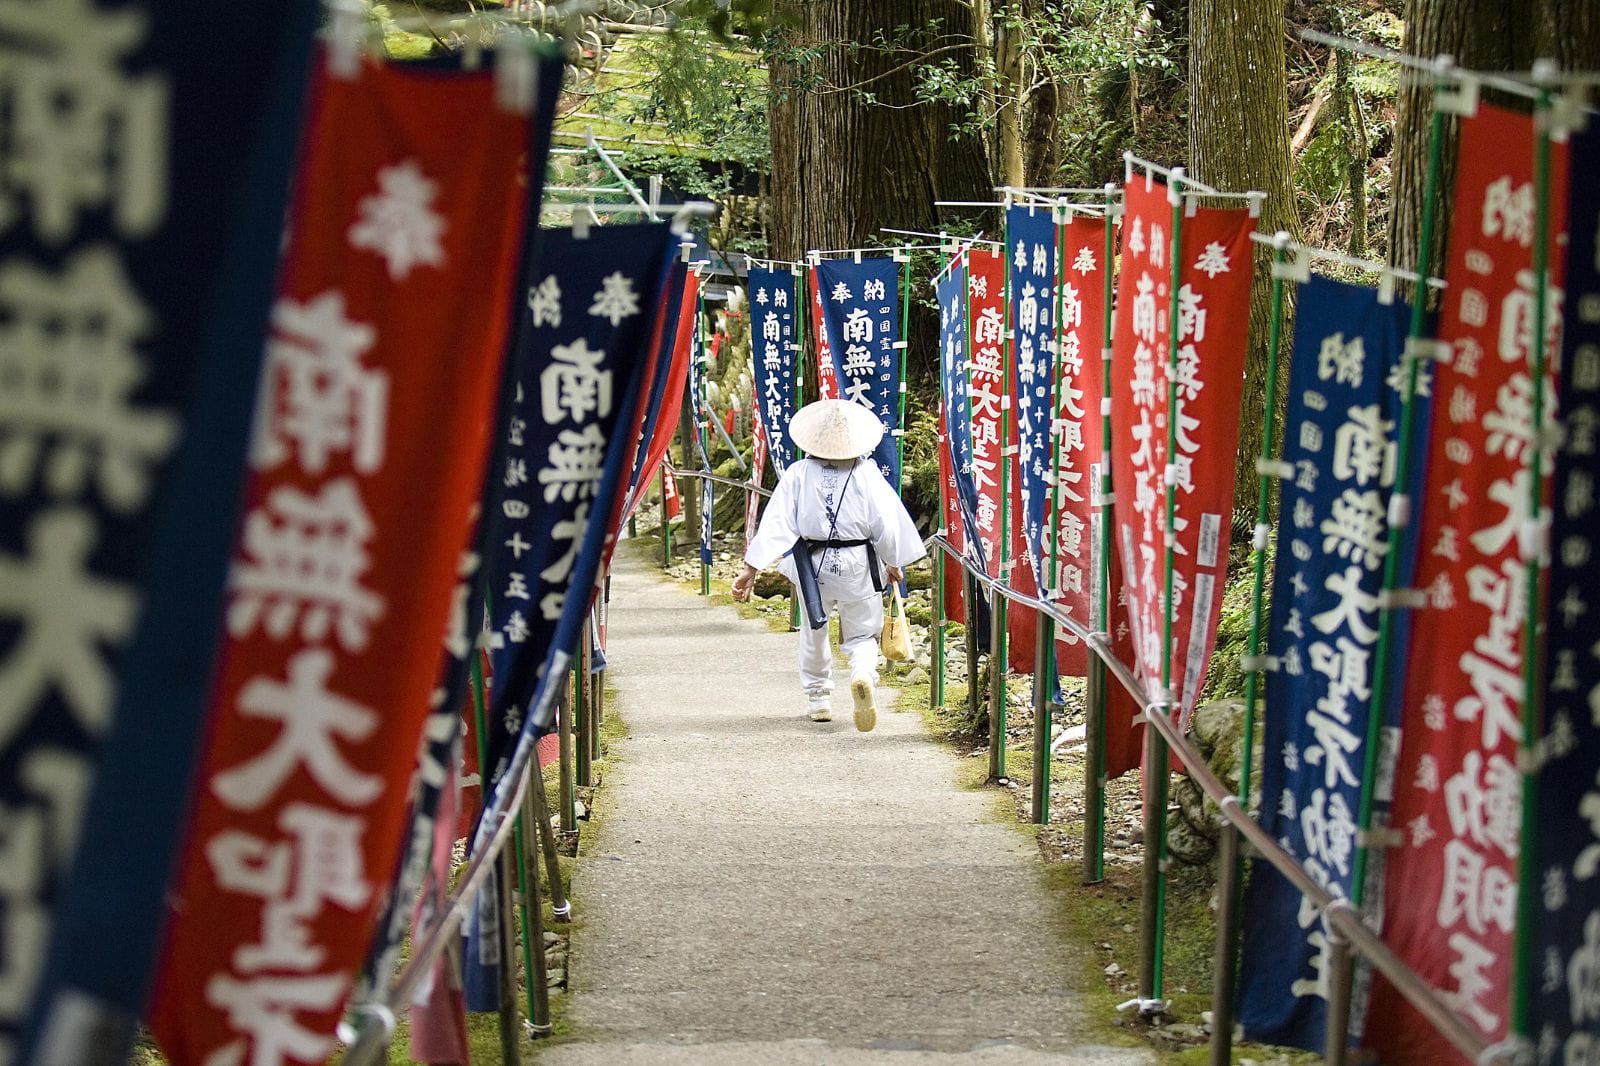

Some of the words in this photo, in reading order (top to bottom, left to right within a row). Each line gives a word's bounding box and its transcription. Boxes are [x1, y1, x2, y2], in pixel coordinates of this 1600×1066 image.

[1014, 239, 1047, 278] 奉納
[756, 286, 788, 308] 奉納
[831, 279, 886, 304] 奉納
[842, 307, 877, 409] 南無大
